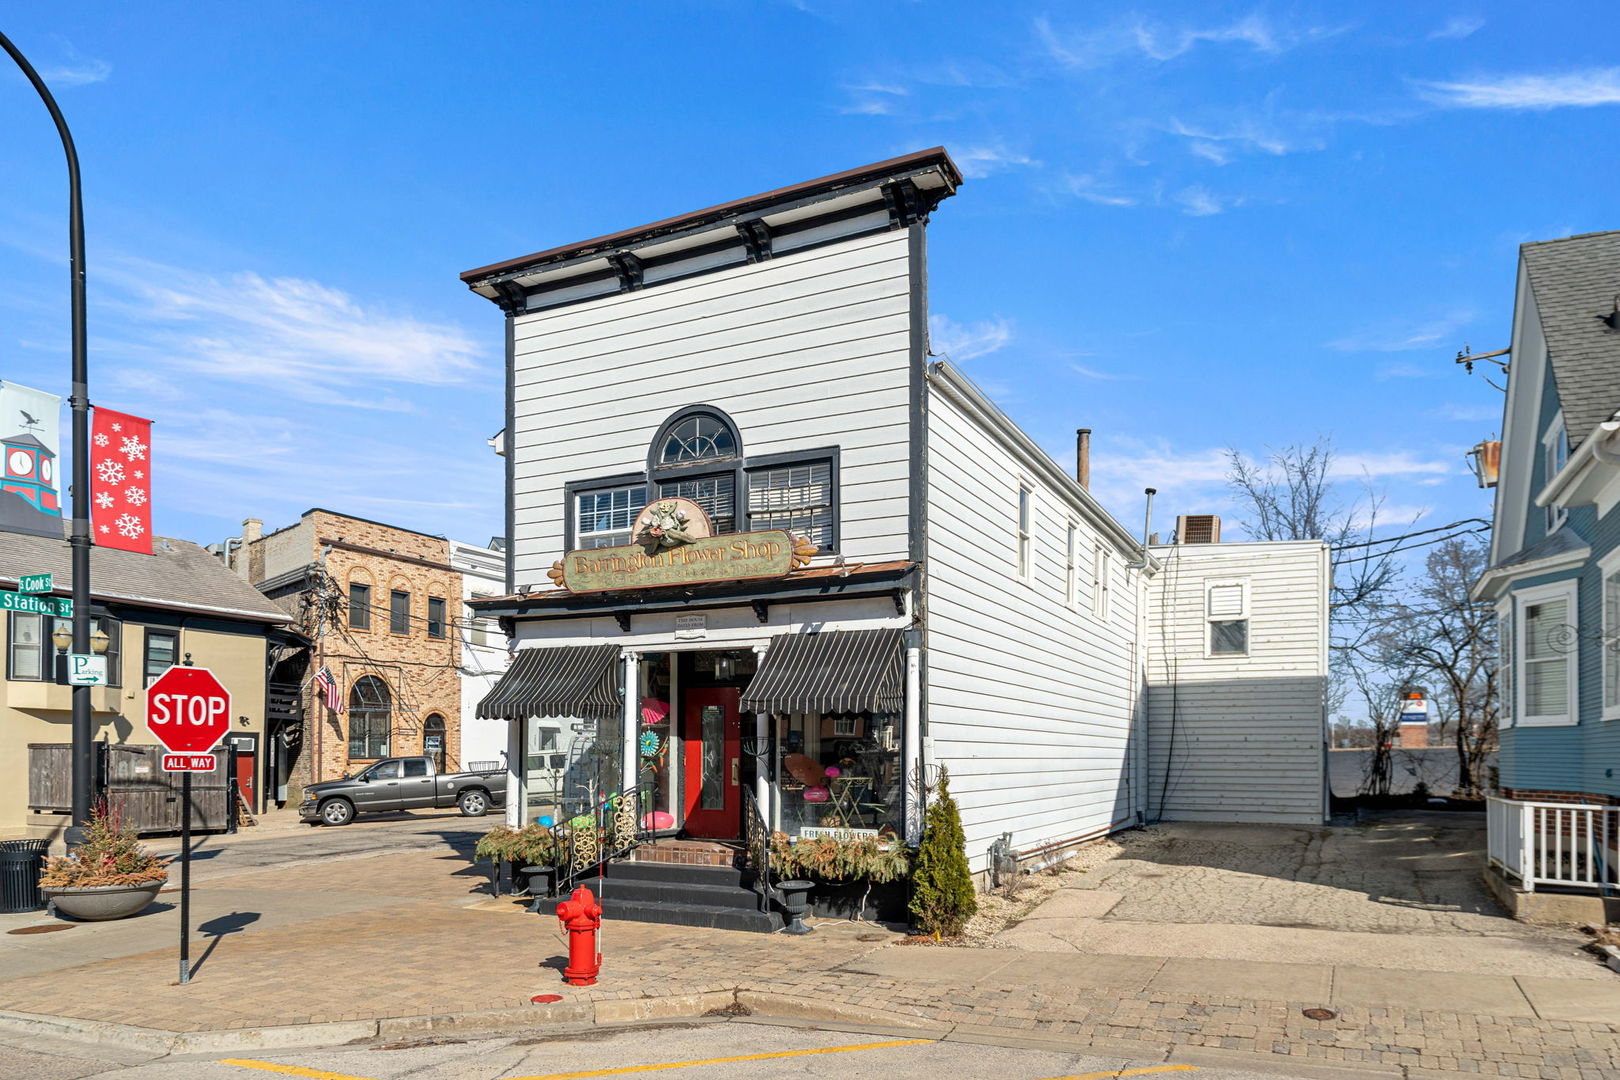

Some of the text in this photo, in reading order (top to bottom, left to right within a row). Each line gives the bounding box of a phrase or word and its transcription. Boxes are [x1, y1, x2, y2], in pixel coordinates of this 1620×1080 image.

[574, 539, 780, 574] Barrington Flower Shop
[25, 577, 44, 591] Cook
[3, 593, 70, 613] Station St
[72, 656, 104, 677] Parking
[151, 693, 226, 726] STOP
[166, 757, 212, 769] ALL WAY
[804, 830, 830, 838] FREH
